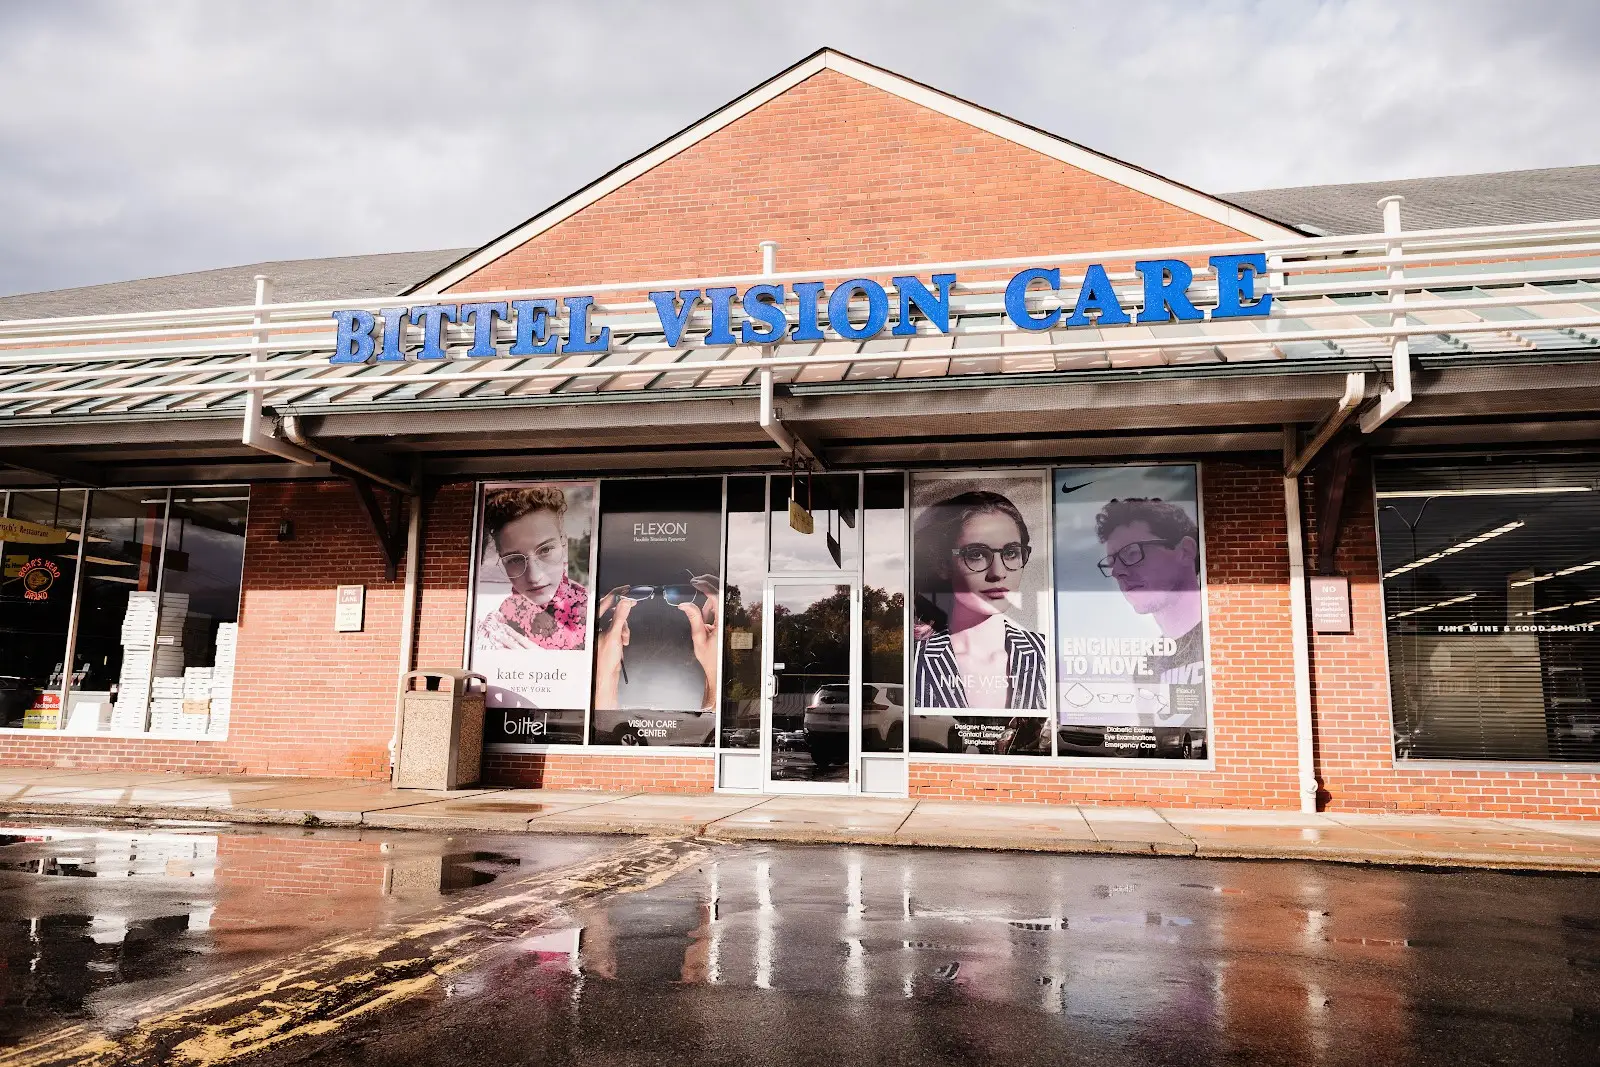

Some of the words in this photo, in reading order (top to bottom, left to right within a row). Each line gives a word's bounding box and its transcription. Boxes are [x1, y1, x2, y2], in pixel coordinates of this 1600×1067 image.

[329, 296, 611, 365] BITTEL
[648, 273, 957, 347] VISION
[1004, 252, 1273, 330] CARE
[633, 522, 687, 535] FLEXON
[45, 560, 61, 578] HEAD
[1322, 585, 1337, 593] NO
[1063, 637, 1177, 656] ENGINEERED
[1064, 656, 1088, 675] TO
[1092, 656, 1154, 676] MOVE.
[497, 668, 525, 680] kate
[528, 669, 567, 683] spade
[940, 674, 973, 688] NINE
[978, 674, 1019, 689] WEST
[42, 695, 53, 703] Big
[503, 711, 547, 735] bittel
[628, 719, 654, 728] VISION
[655, 720, 677, 728] CARE
[637, 729, 667, 738] CENTER
[1104, 734, 1115, 742] Eye
[1104, 742, 1139, 750] Emergency
